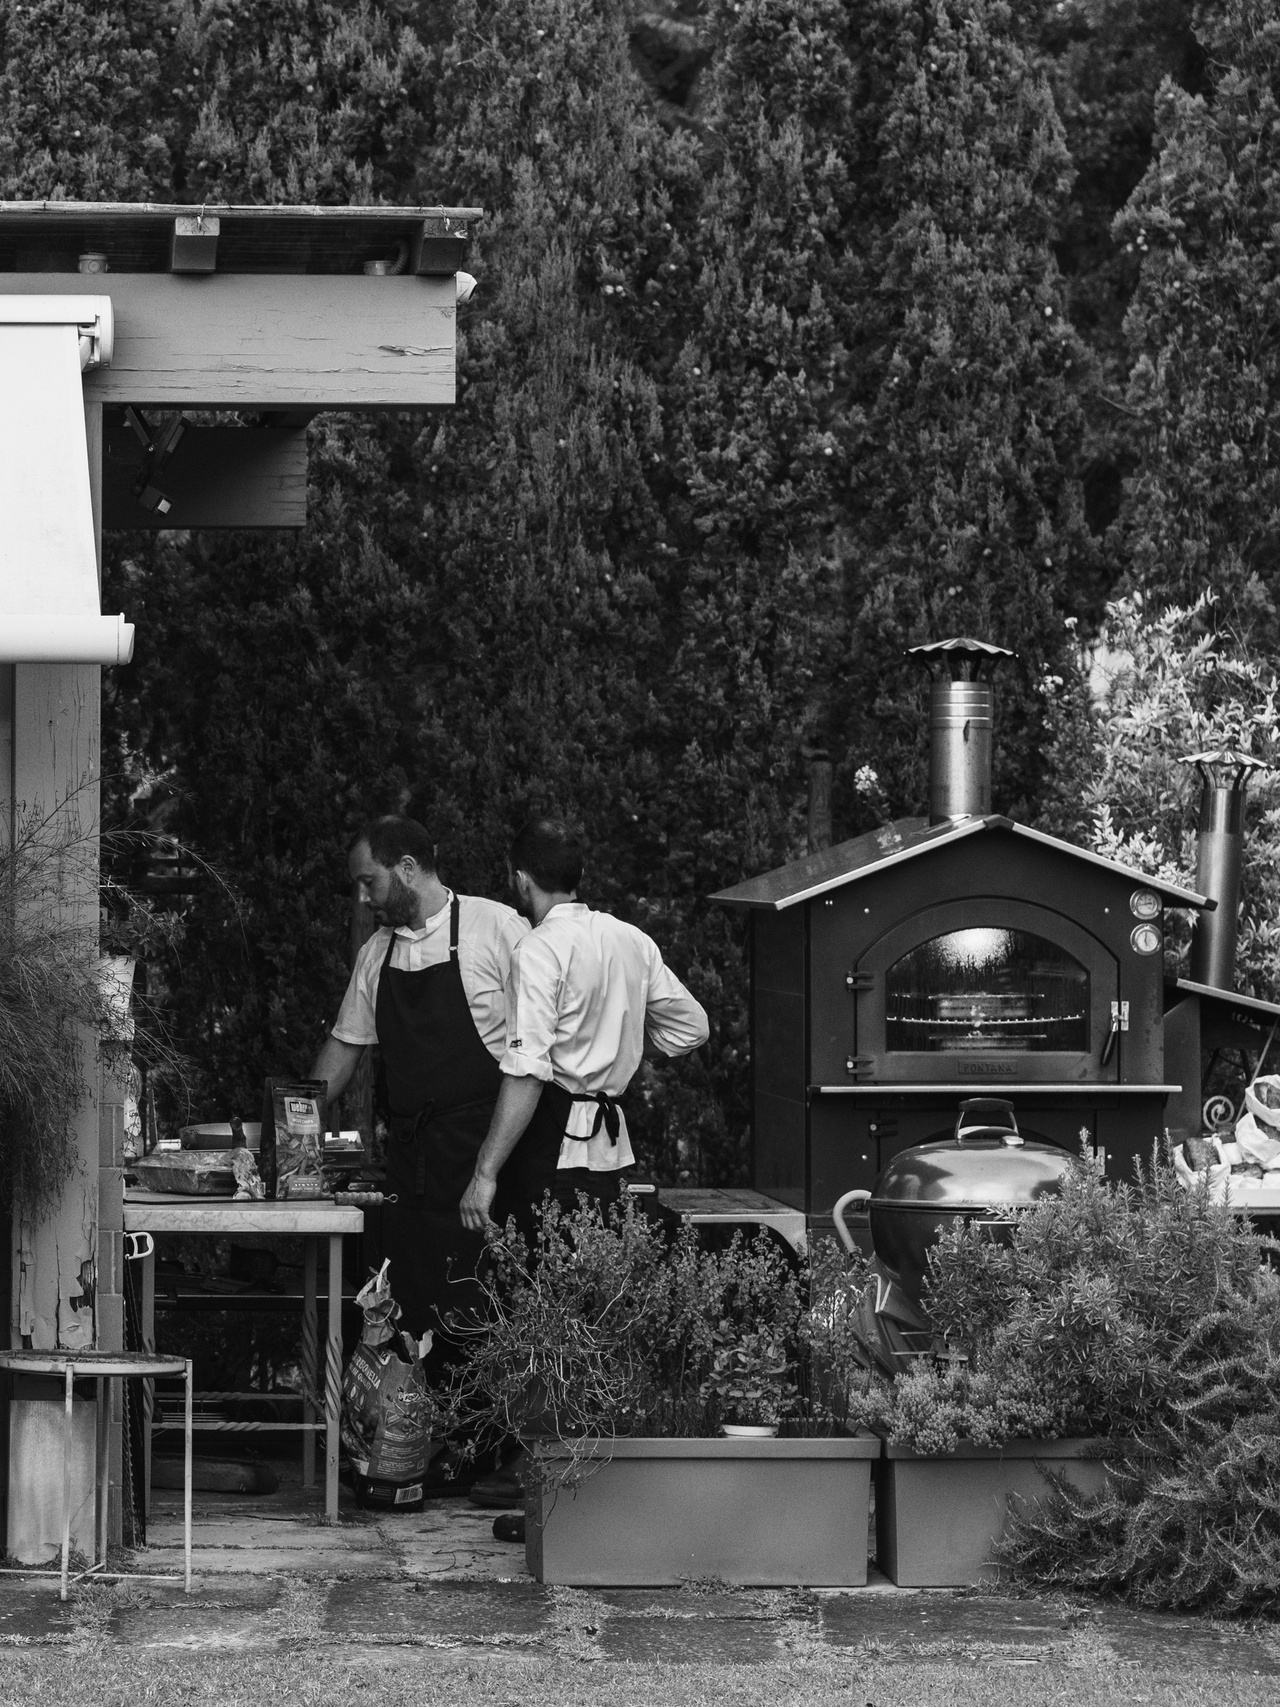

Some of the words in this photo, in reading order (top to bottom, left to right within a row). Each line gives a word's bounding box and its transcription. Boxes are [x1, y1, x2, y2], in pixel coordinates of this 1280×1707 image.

[963, 1063, 1012, 1072] FONTANA
[290, 1101, 308, 1114] weber
[352, 1350, 381, 1390] ARBONELLA
